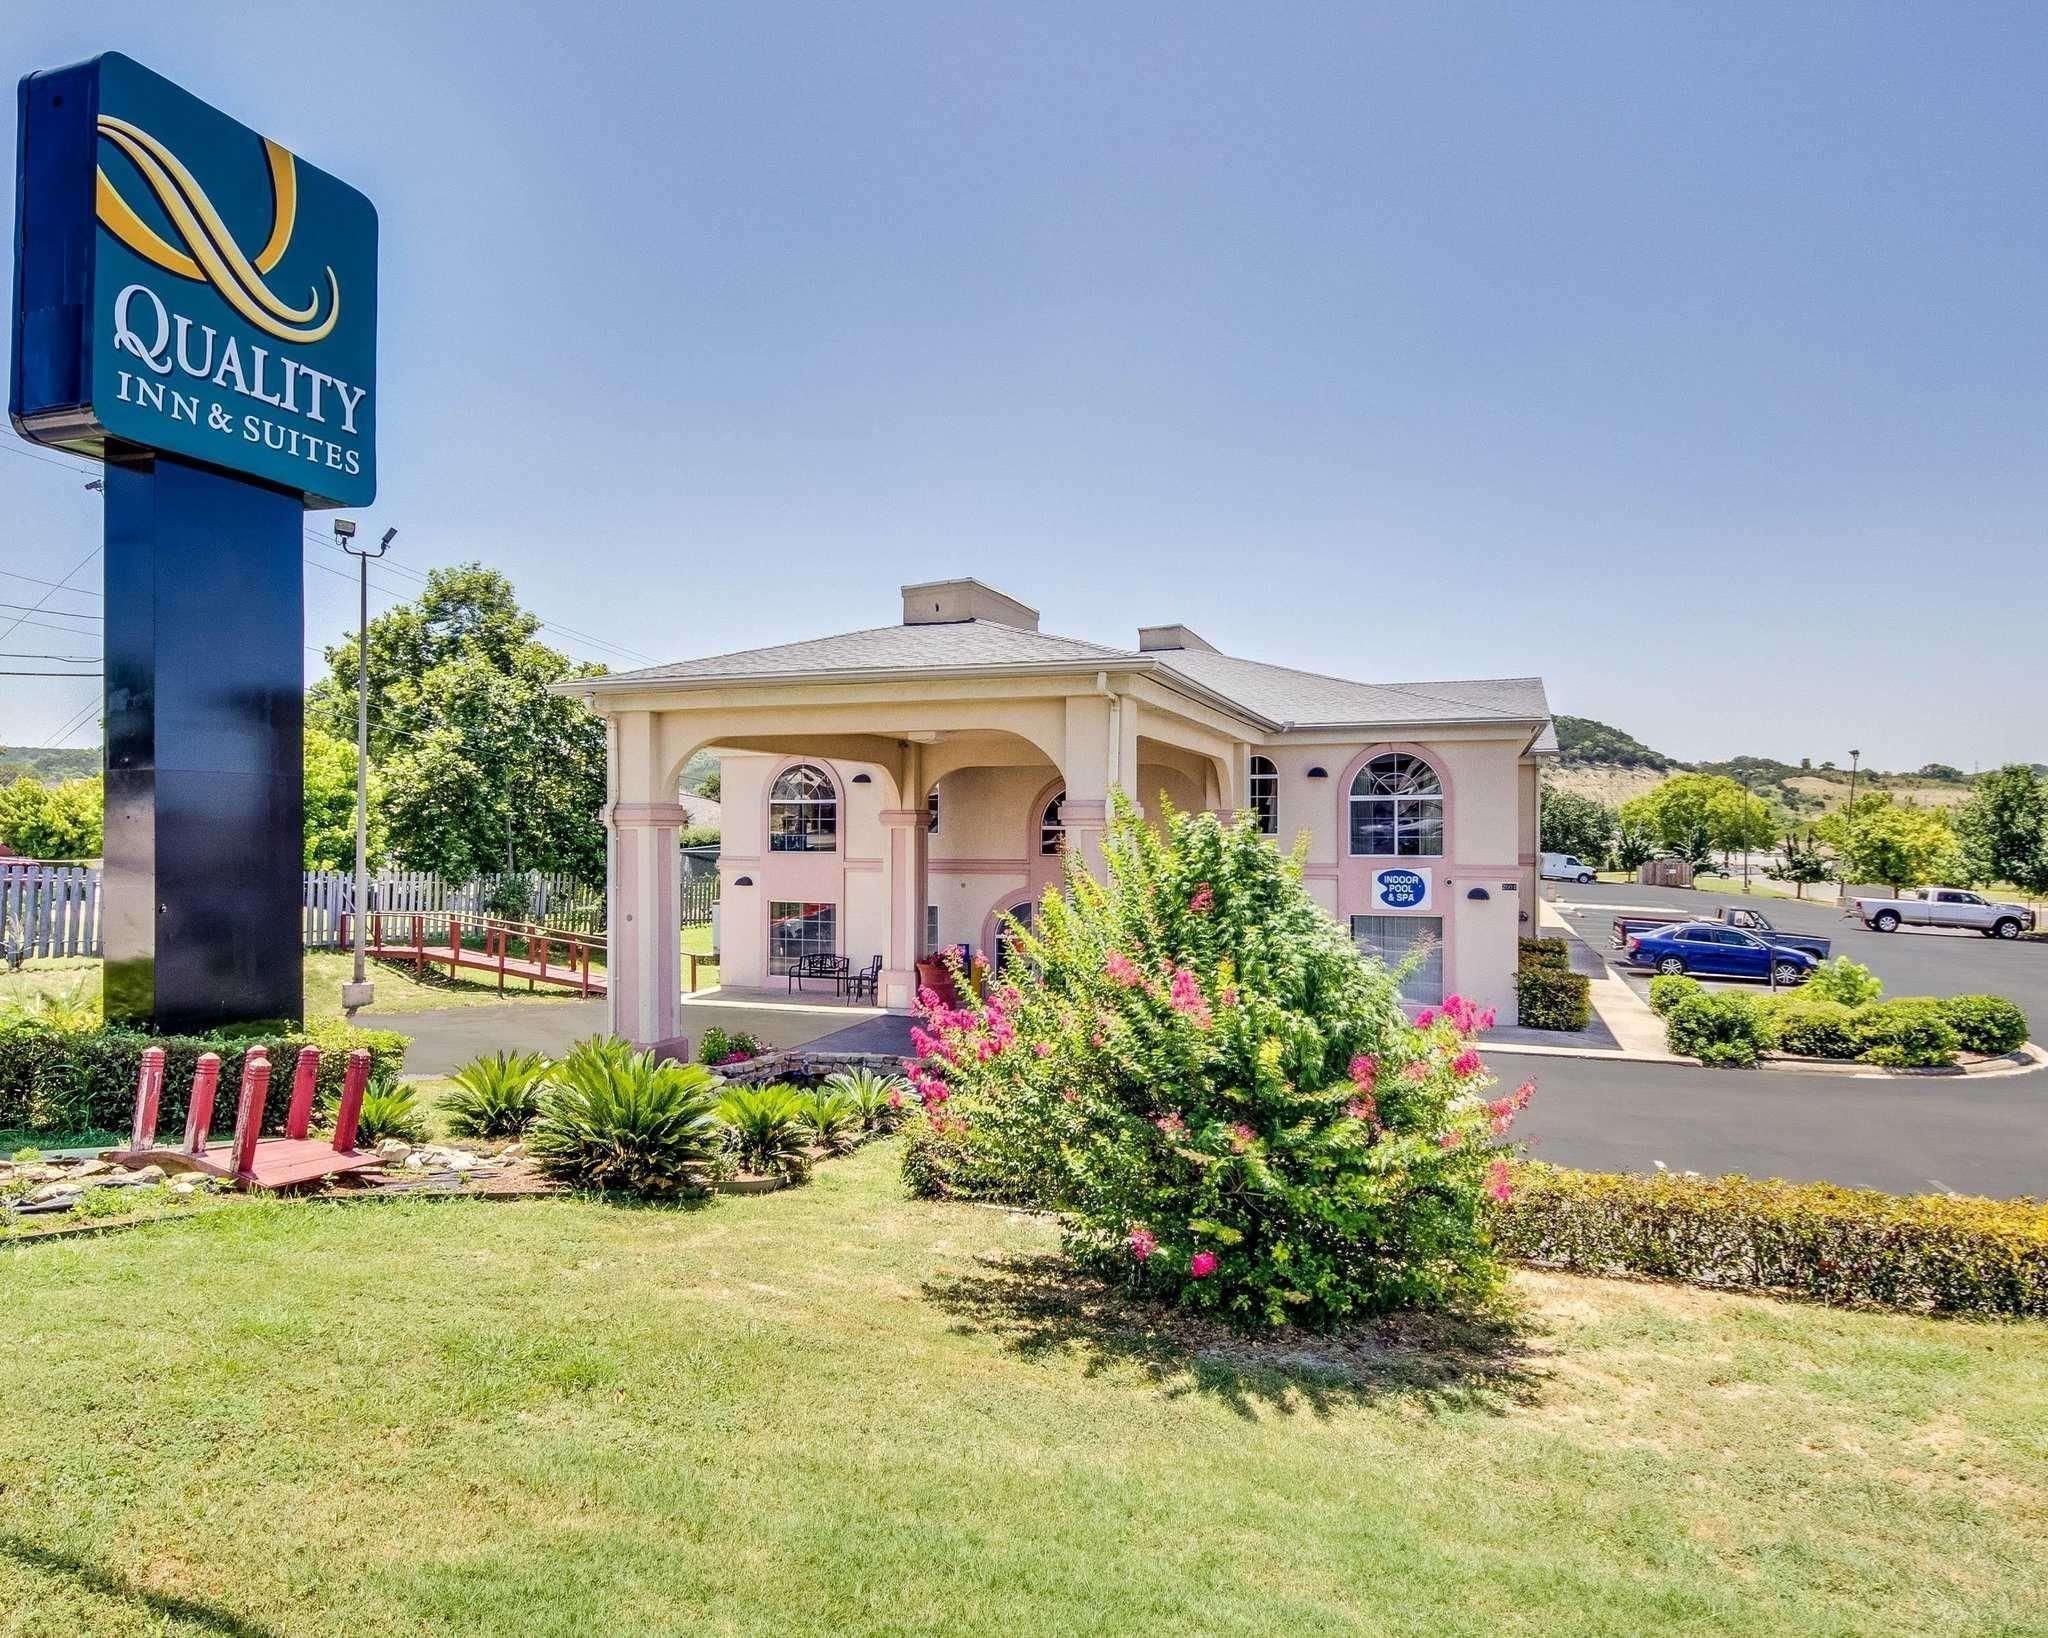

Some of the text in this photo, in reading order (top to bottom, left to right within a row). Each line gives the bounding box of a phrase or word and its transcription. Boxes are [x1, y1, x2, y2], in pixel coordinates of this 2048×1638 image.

[114, 284, 366, 434] QUALITY
[116, 371, 361, 475] INN & SUITES
[1384, 875, 1419, 884] INDOOR
[1389, 884, 1414, 893] POOL
[1388, 893, 1415, 902] & SPA
